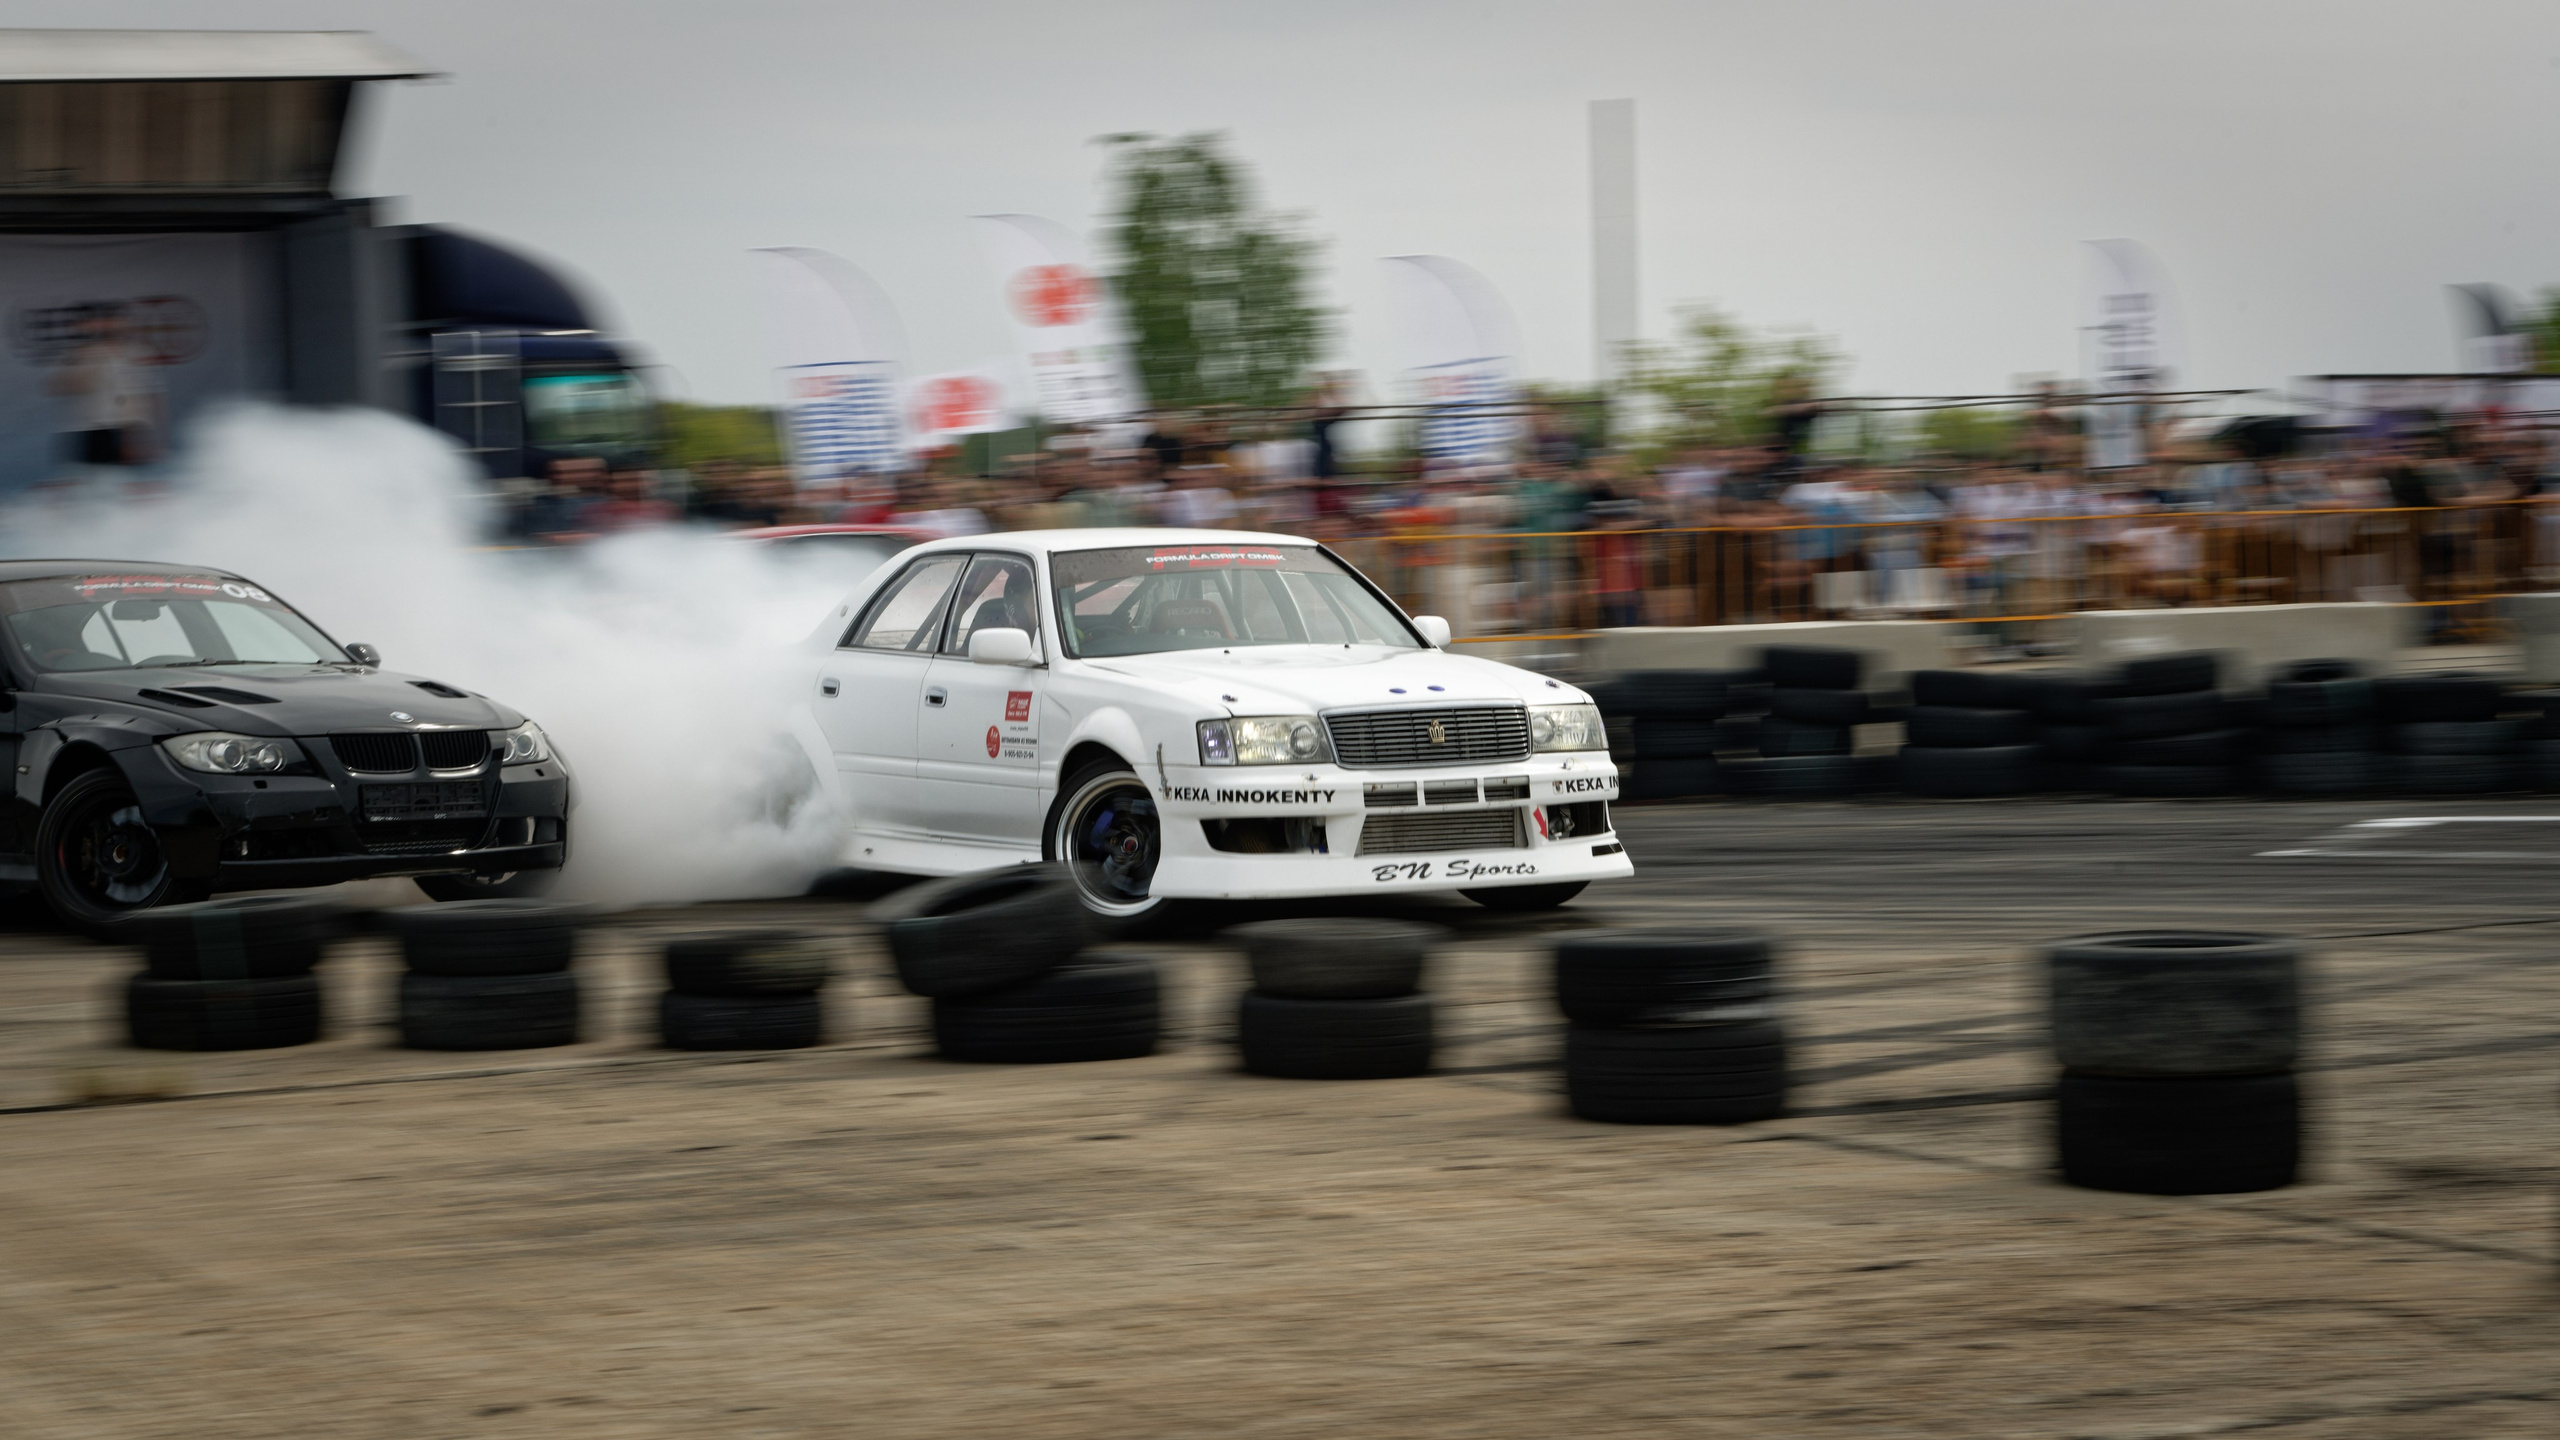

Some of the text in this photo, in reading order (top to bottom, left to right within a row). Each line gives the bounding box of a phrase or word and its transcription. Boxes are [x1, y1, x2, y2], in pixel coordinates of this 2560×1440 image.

[1146, 552, 1286, 564] FORMULA DRIFT OMSK
[1167, 606, 1212, 616] RECARO
[1174, 787, 1335, 805] KEXA_INNOKENTY
[1372, 860, 1539, 882] BN Sports
